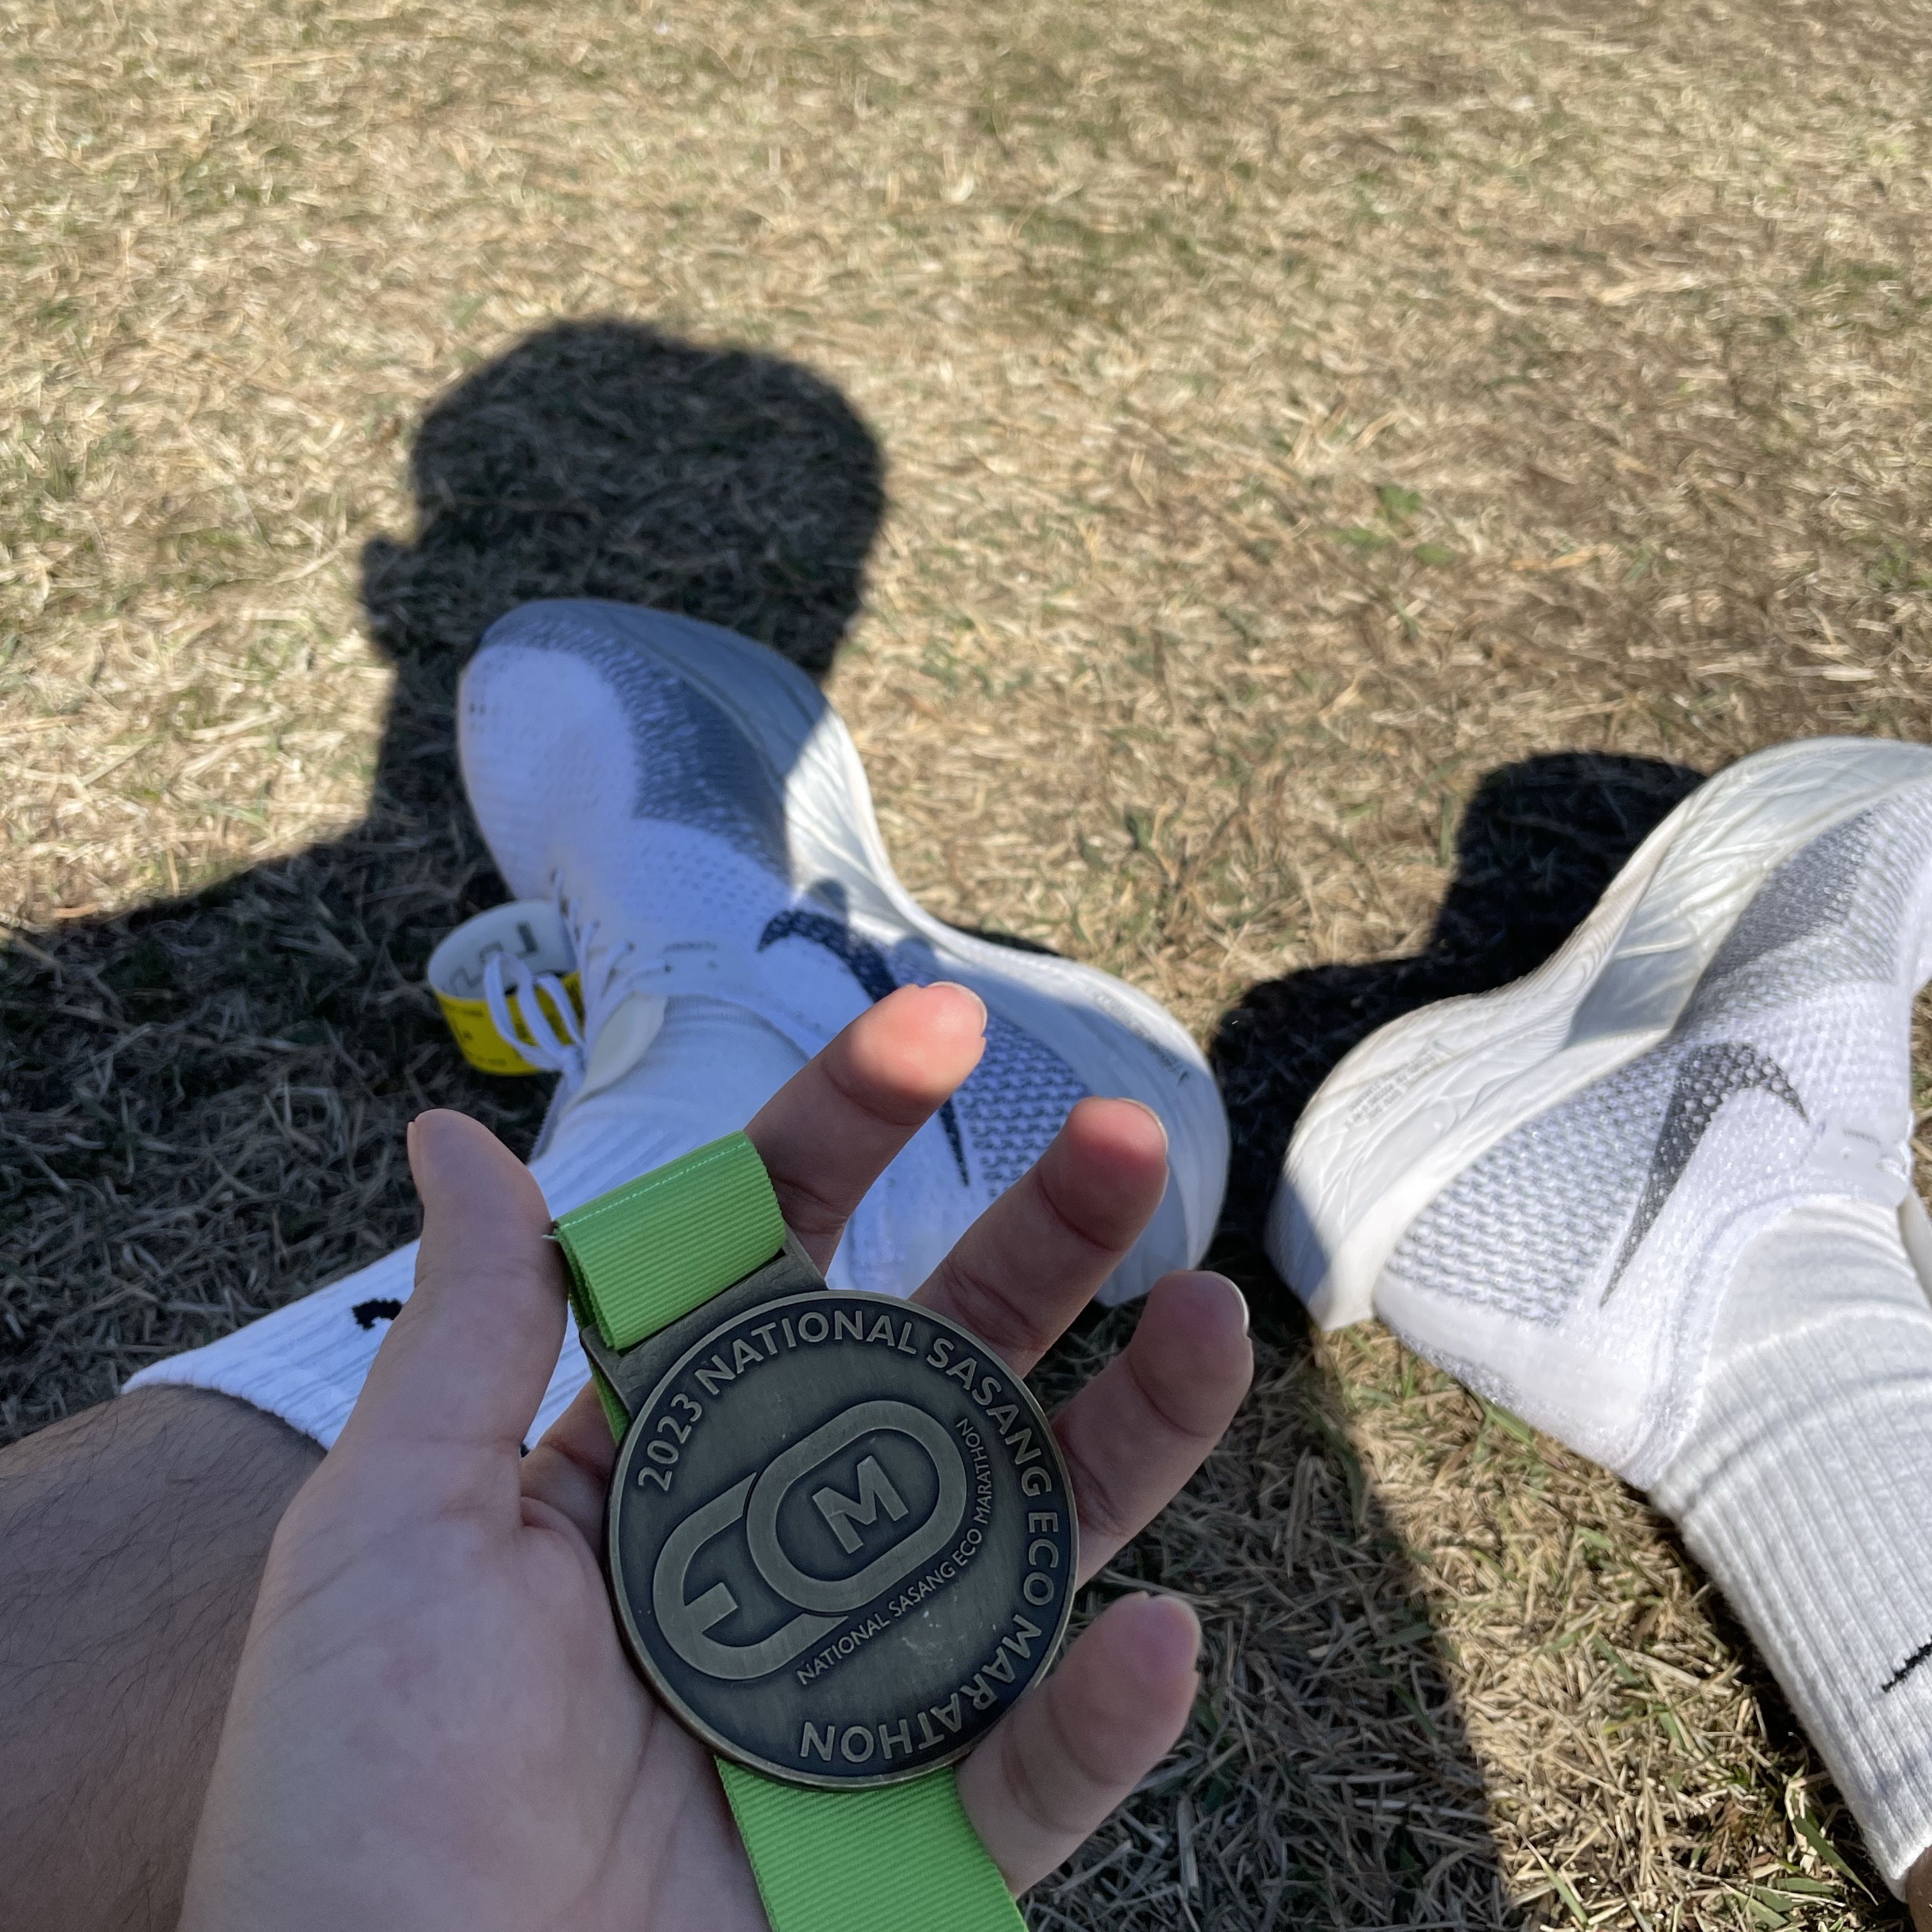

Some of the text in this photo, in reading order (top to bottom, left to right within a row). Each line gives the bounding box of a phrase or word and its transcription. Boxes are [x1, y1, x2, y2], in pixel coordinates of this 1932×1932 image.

[638, 1310, 1059, 1762] 2023 NATIONAL SASANG ECO MARATHON
[797, 1418, 992, 1685] NATIONAL SASANG ECO MARATHON
